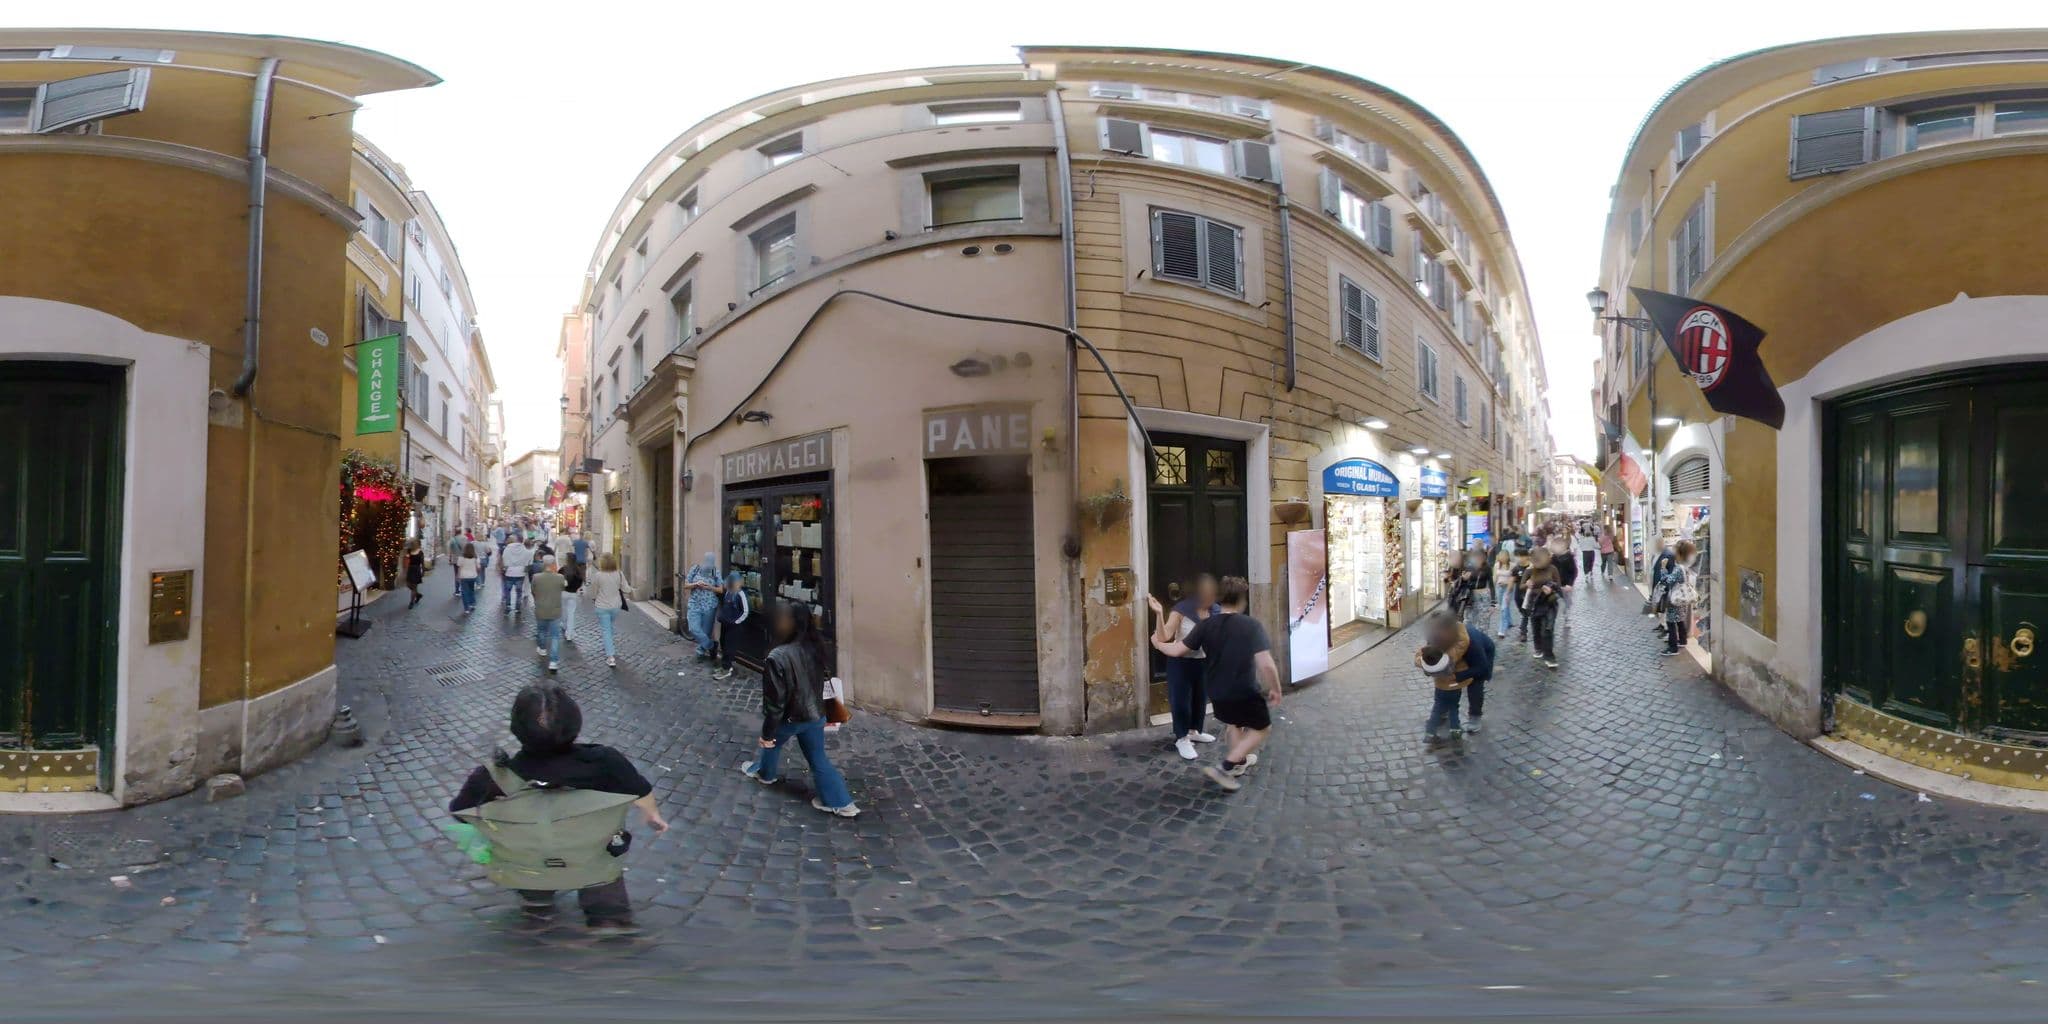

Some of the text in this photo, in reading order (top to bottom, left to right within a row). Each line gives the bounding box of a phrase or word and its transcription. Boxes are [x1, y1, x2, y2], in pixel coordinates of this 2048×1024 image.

[370, 348, 382, 413] CHANGE
[928, 414, 1028, 452] PANE
[726, 437, 825, 480] FORMAGGI
[1334, 465, 1368, 481] ORIGINAL
[1356, 482, 1376, 493] GLASS
